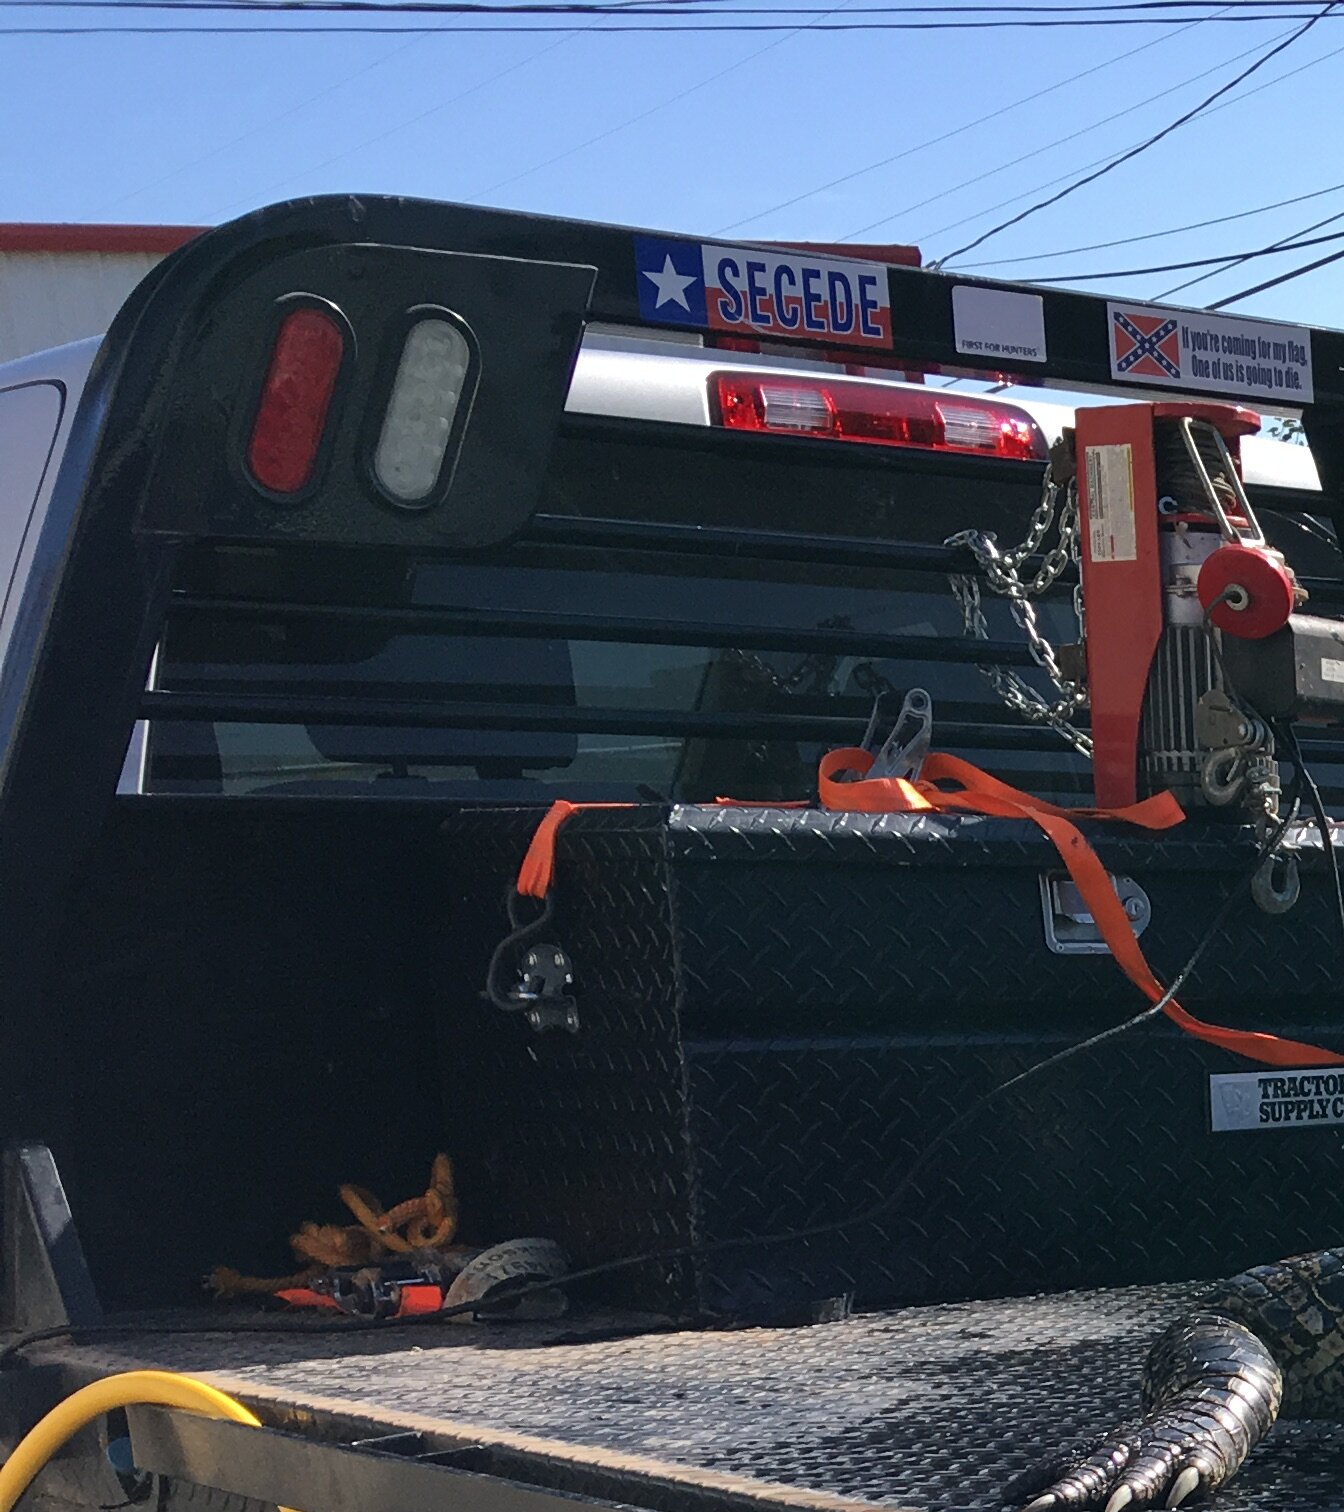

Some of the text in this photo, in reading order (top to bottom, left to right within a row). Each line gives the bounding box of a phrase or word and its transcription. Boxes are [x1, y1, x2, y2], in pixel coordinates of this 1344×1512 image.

[717, 258, 884, 338] SECEDE
[962, 340, 1037, 357] FIRST FOR HUNTERS
[1182, 326, 1189, 349] If
[1190, 330, 1220, 353] you're
[1221, 334, 1257, 360] coming
[1258, 336, 1271, 360] for
[1273, 341, 1286, 364] my
[1191, 354, 1302, 390] One of us is going to die.
[1259, 1098, 1330, 1123] SUPPLY
